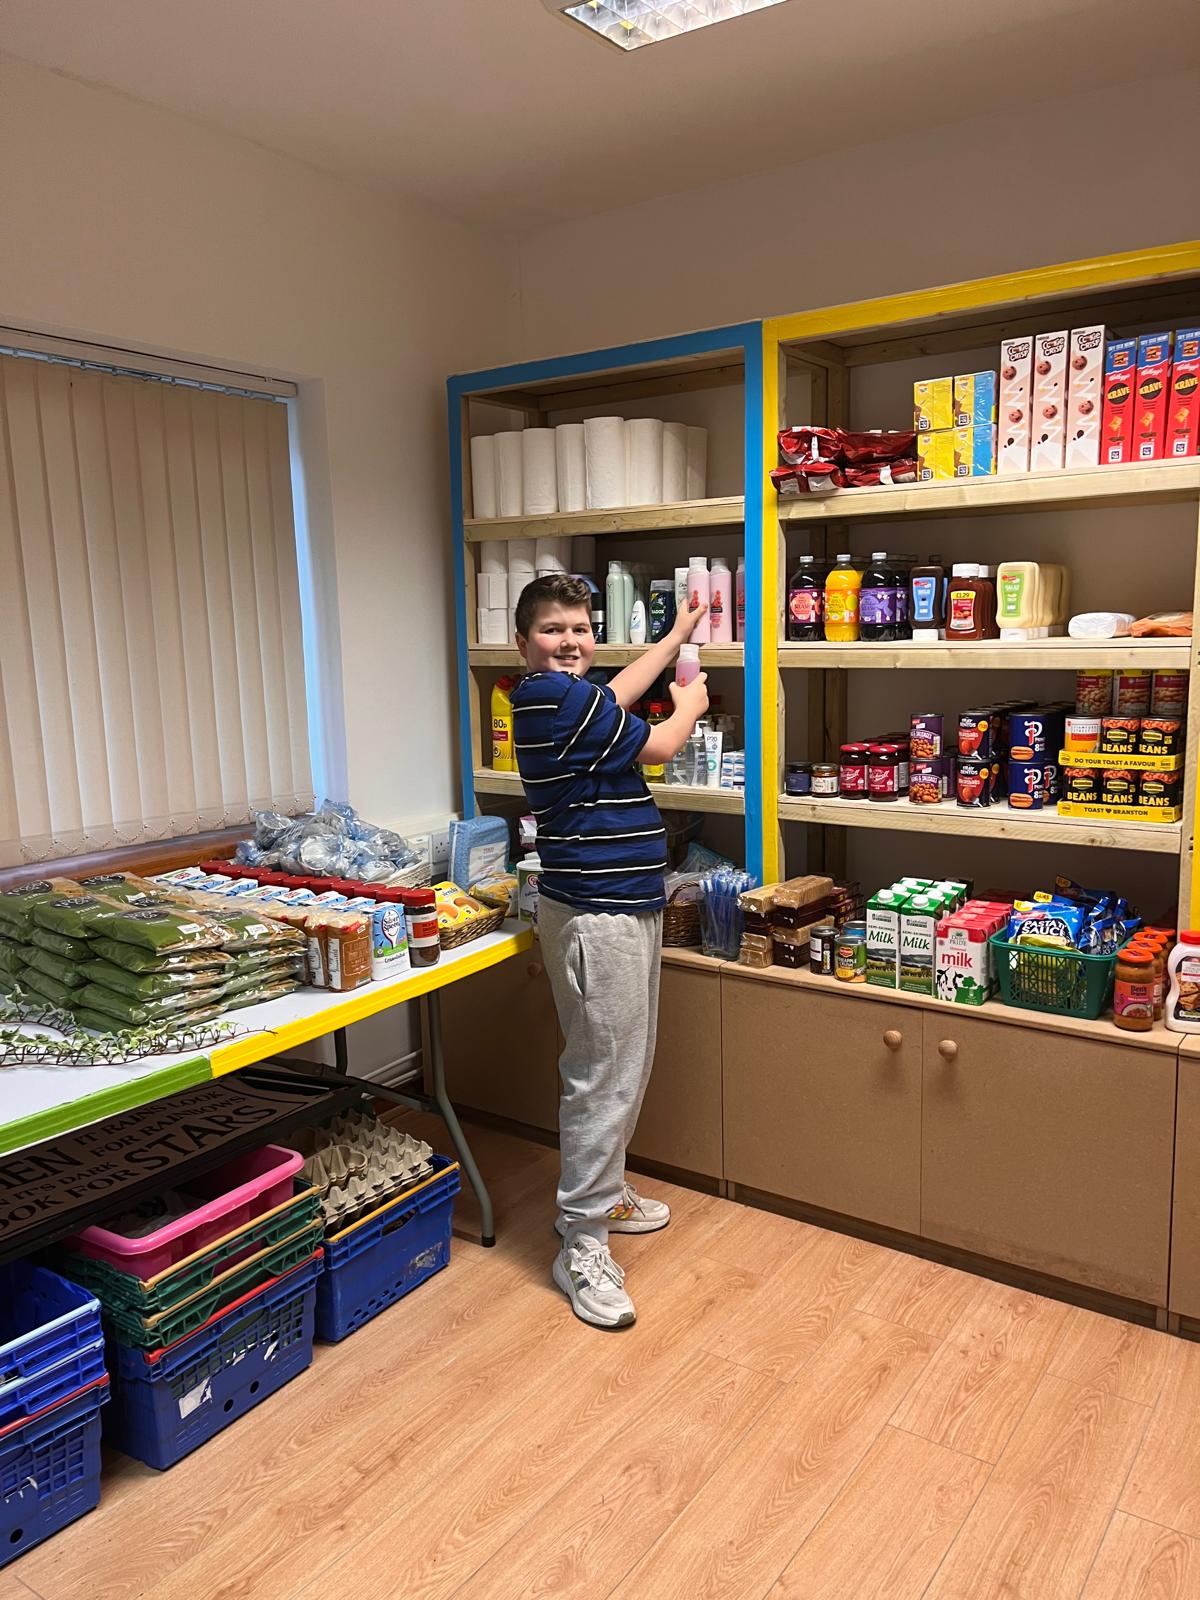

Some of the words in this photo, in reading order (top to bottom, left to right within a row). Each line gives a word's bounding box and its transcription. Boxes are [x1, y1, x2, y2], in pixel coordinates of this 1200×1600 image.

[1139, 381, 1163, 395] KRAVE
[1174, 377, 1199, 390] KRAVE
[1107, 386, 1130, 400] KRAVE
[494, 718, 507, 729] 80p
[1034, 743, 1040, 752] 8
[1102, 743, 1133, 753] BEANS
[1034, 790, 1039, 799] 8
[1067, 792, 1097, 801] BEANS
[1102, 793, 1133, 804] BEANS
[1024, 920, 1058, 928] PASTA
[868, 930, 894, 945] Milk
[902, 936, 930, 950] Milk
[941, 952, 973, 968] milk
[73, 1132, 99, 1146] IT
[101, 1106, 167, 1135] RAINS
[168, 1090, 224, 1108] LOOK
[90, 1135, 140, 1158] FOR
[139, 1096, 246, 1136] RAINBOWS
[64, 1169, 140, 1198] FOR
[125, 1105, 277, 1170] STARS
[14, 1183, 56, 1199] IT'S
[59, 1161, 118, 1184] DARK
